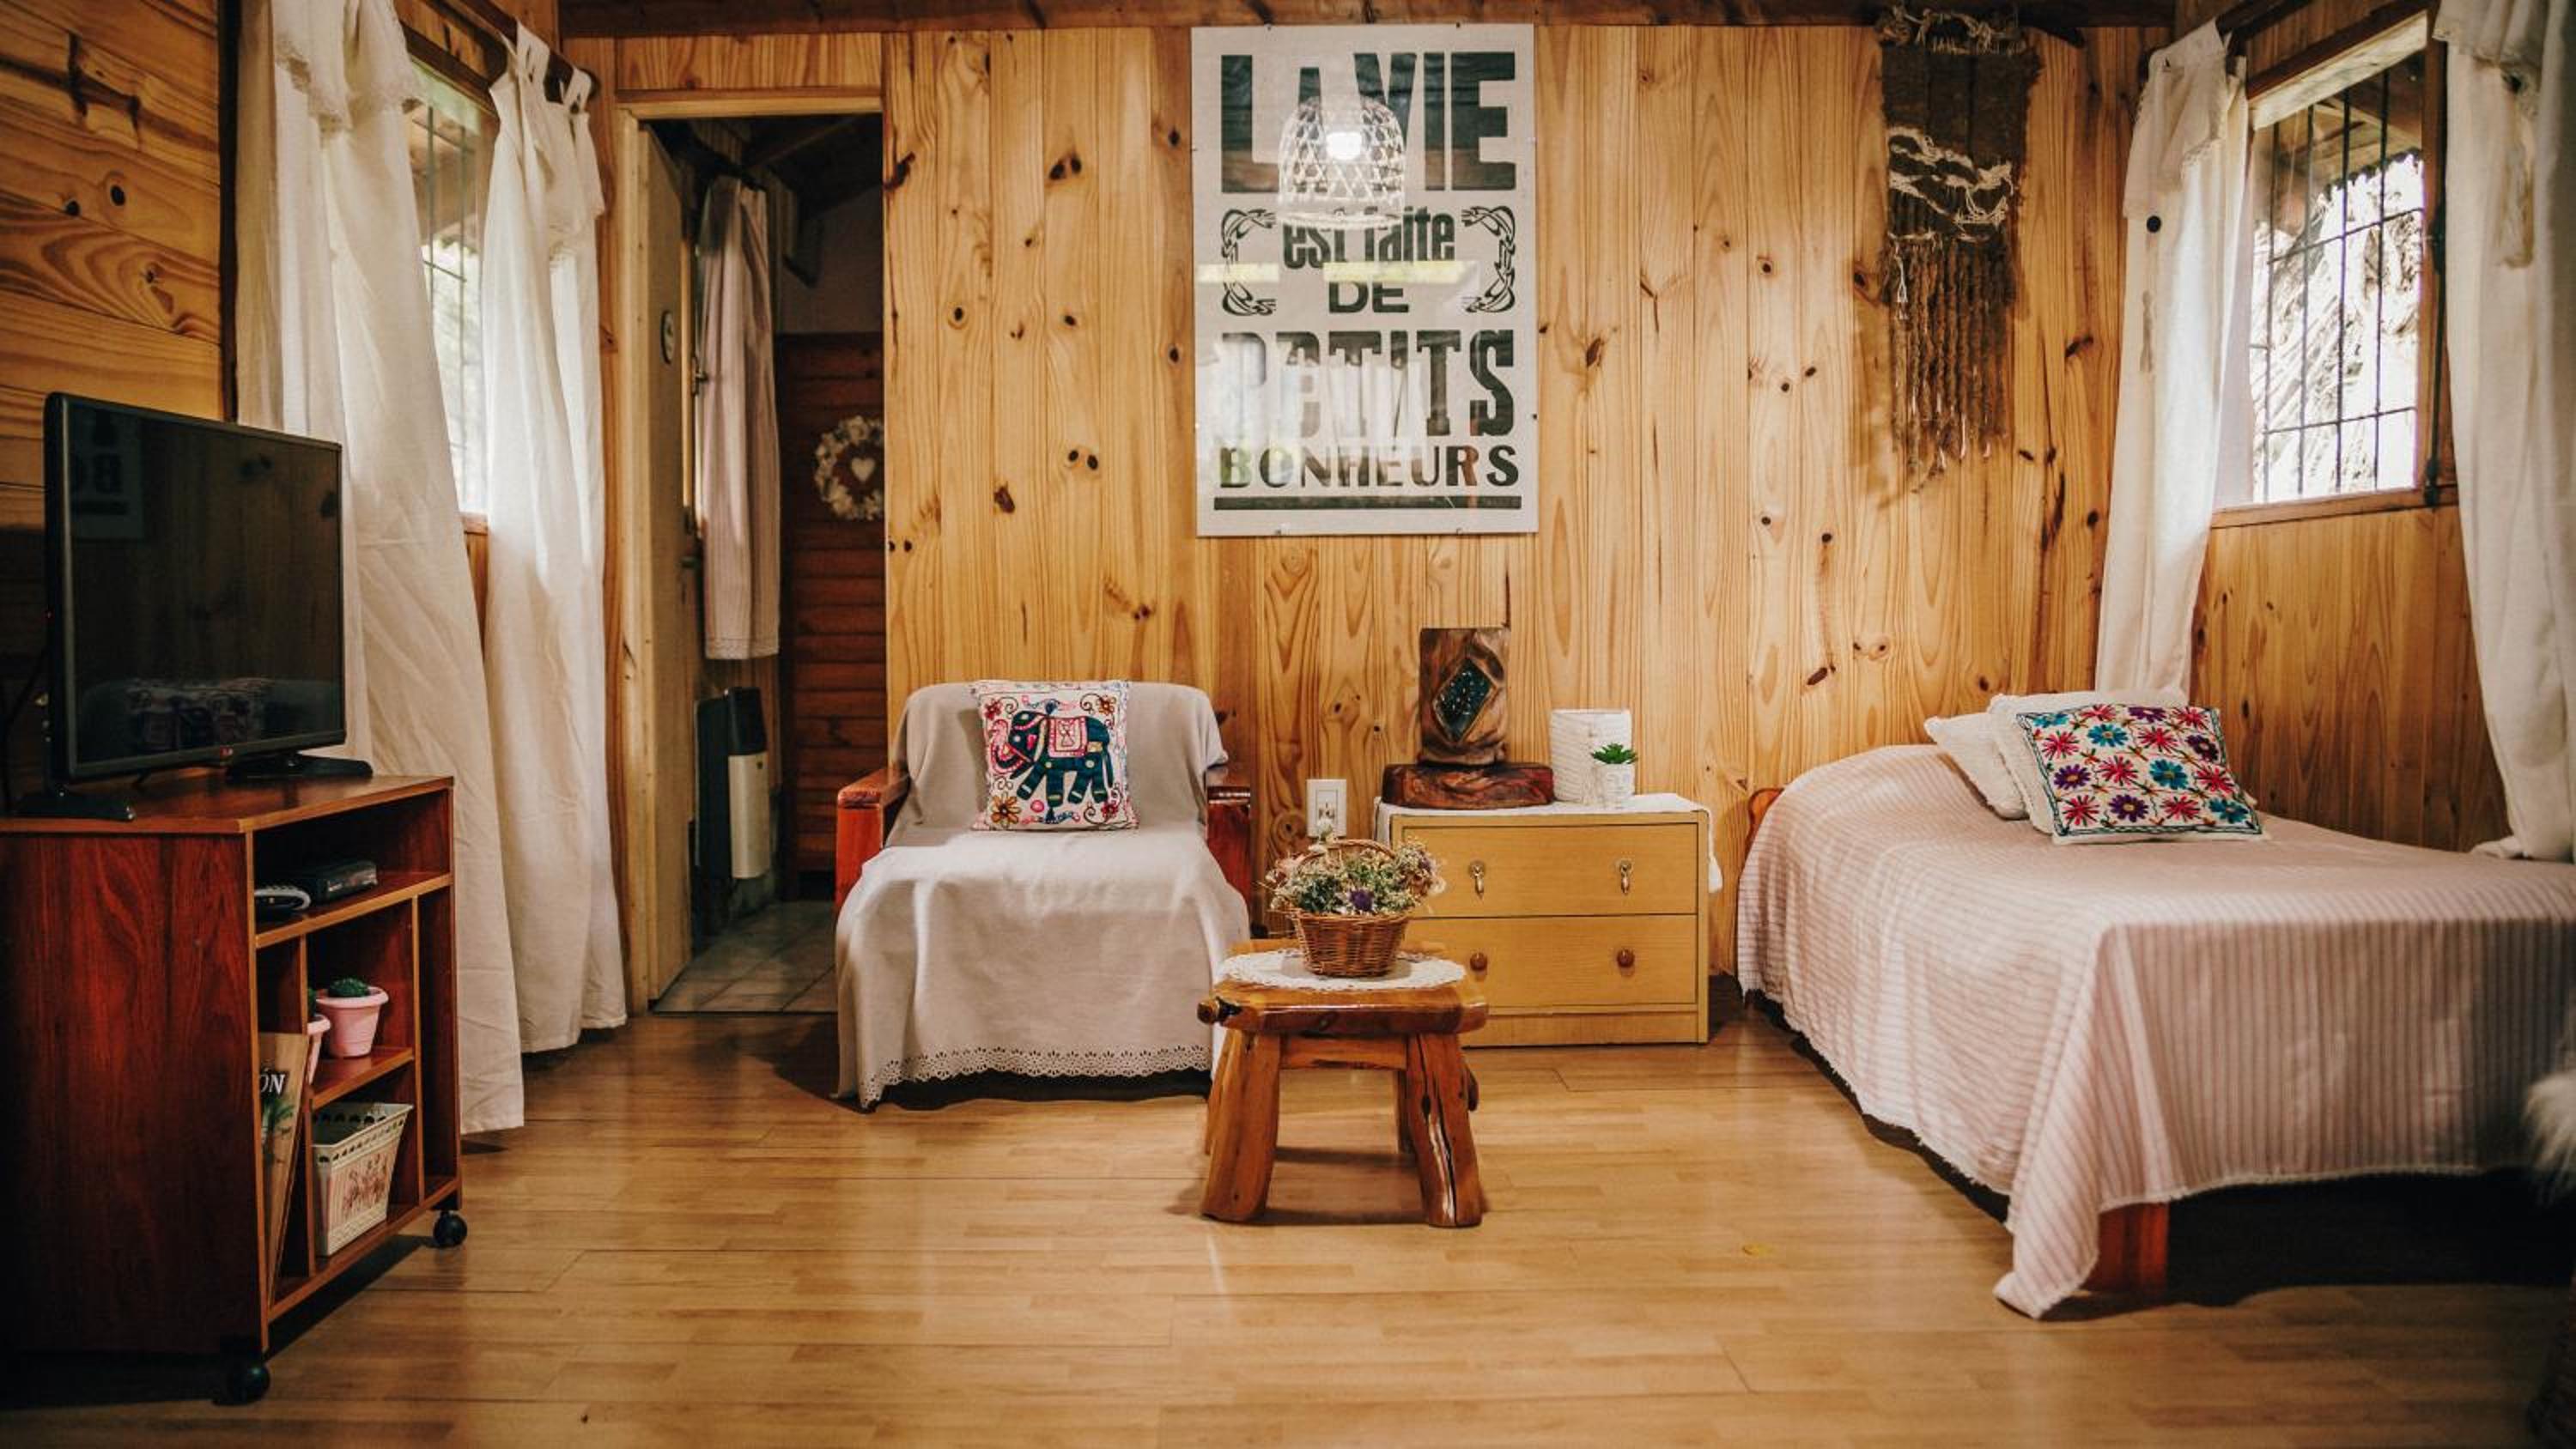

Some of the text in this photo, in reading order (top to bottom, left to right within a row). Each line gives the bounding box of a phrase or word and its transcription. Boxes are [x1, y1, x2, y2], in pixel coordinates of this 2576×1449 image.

[1354, 52, 1516, 192] VIE
[1283, 205, 1455, 270] est faite
[1328, 278, 1409, 313] DE
[1219, 445, 1520, 488] BONHEURS
